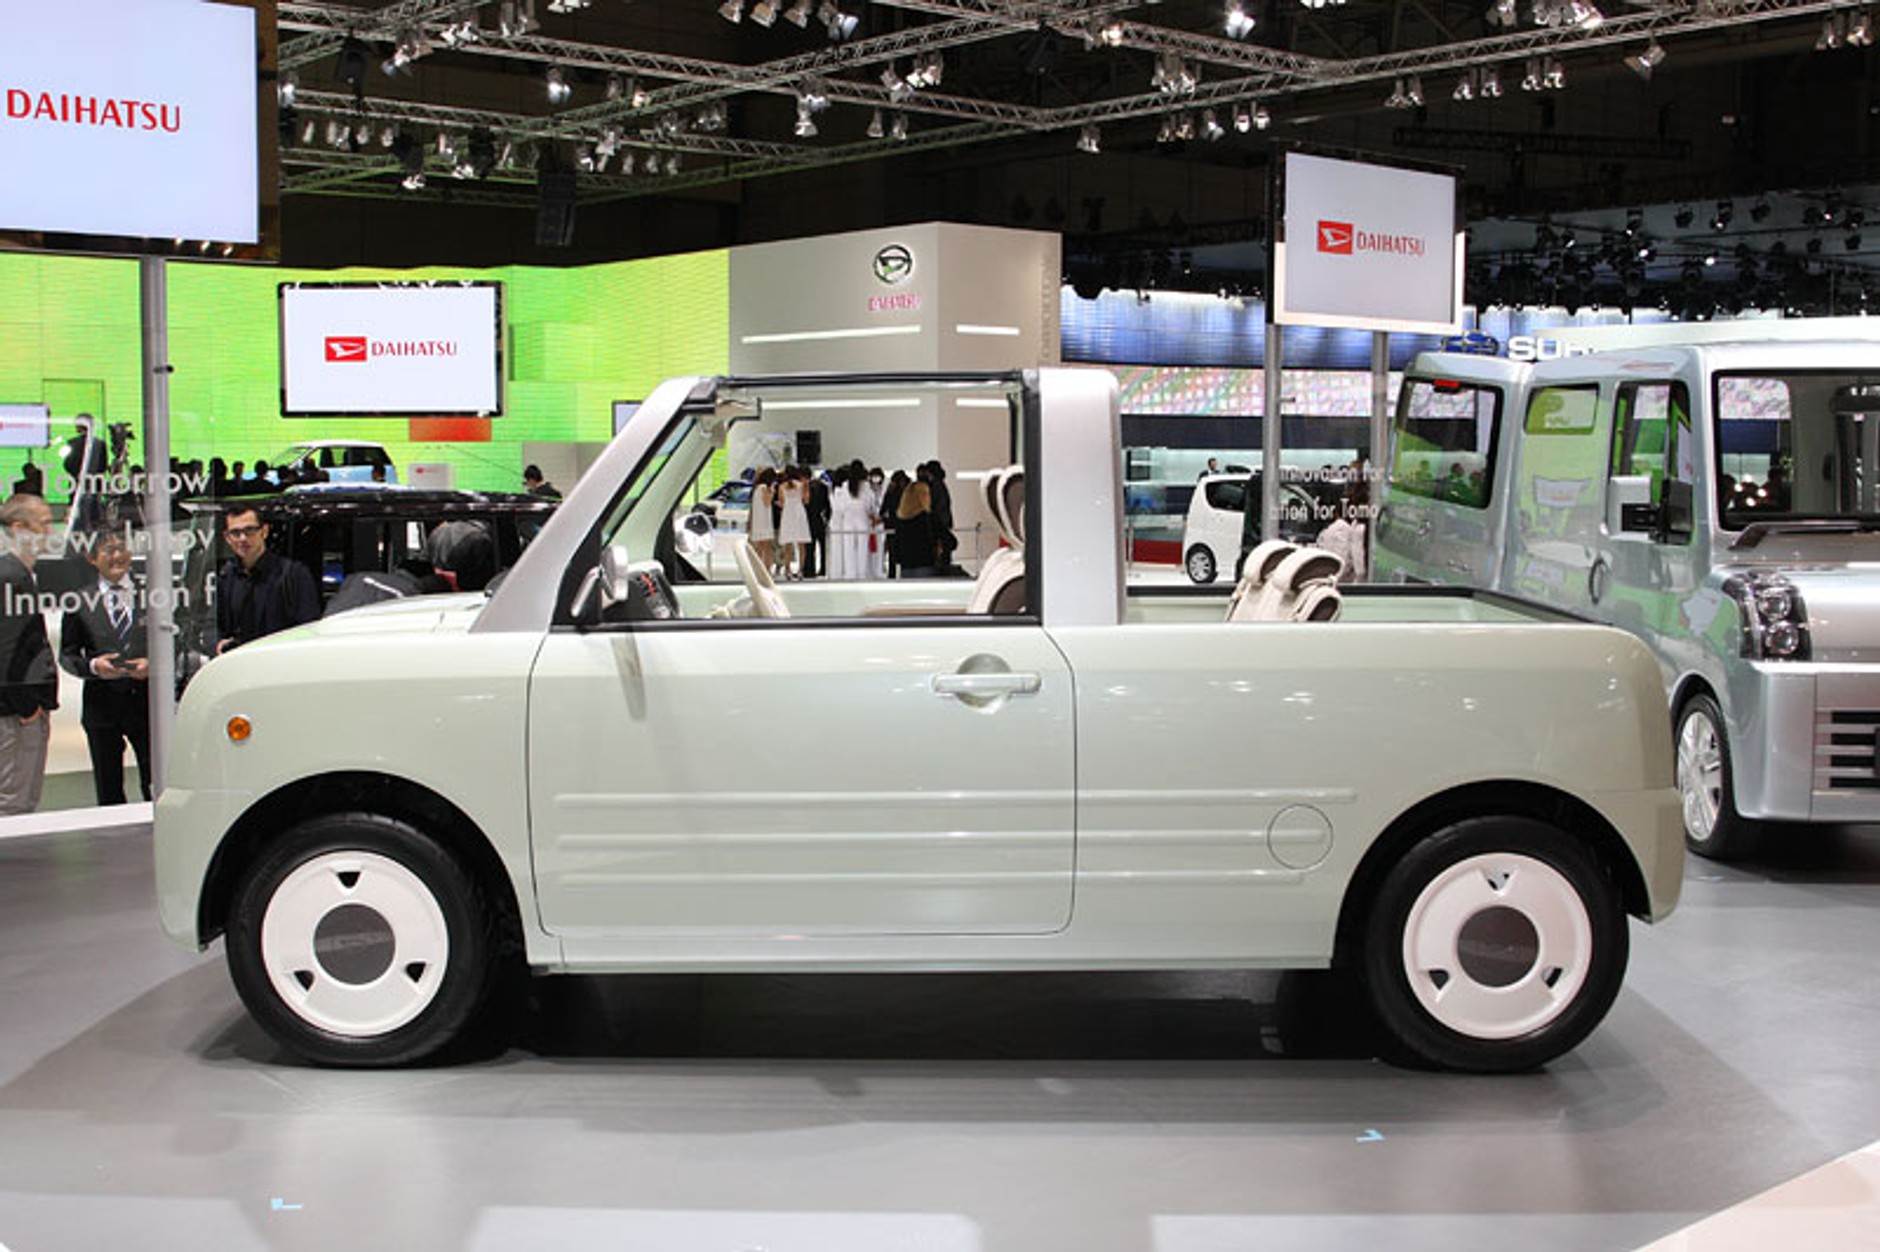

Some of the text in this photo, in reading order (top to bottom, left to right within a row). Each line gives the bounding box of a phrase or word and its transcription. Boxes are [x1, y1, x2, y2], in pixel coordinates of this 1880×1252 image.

[6, 88, 181, 133] DAIHATSU
[1356, 230, 1426, 257] DAIHATSU
[371, 341, 458, 357] DAIHATSU
[36, 462, 211, 496] Tomorrow
[1313, 495, 1336, 521] for
[124, 519, 216, 551] Inov
